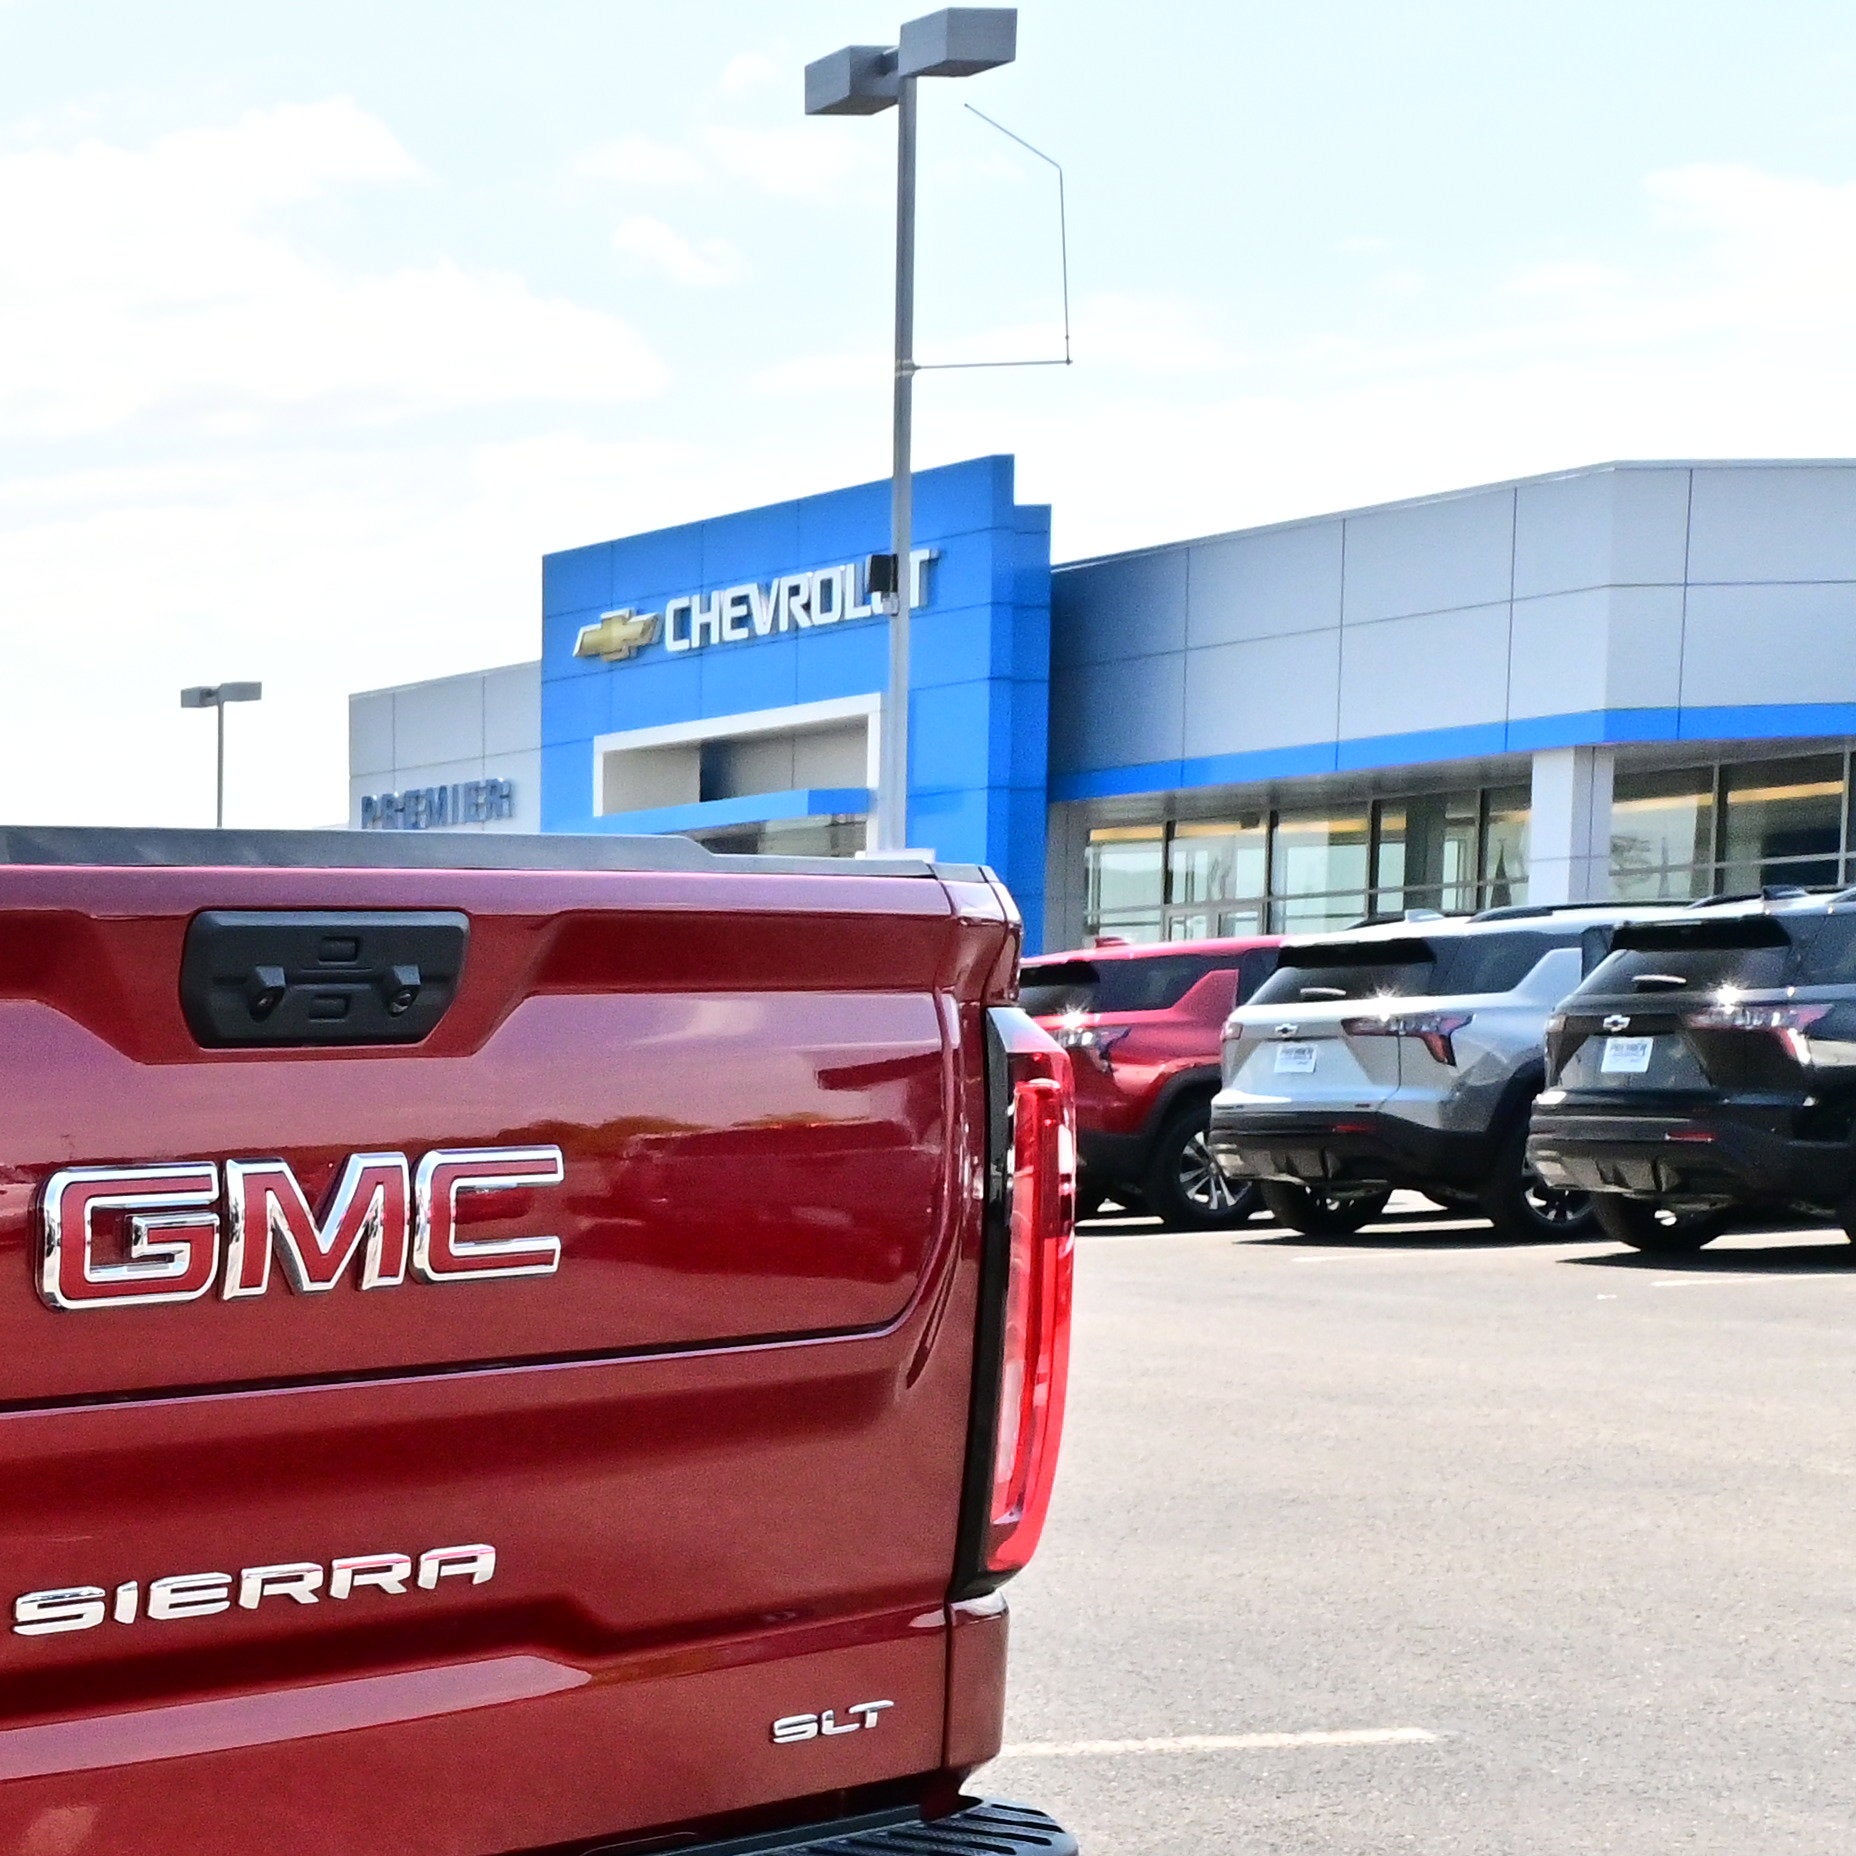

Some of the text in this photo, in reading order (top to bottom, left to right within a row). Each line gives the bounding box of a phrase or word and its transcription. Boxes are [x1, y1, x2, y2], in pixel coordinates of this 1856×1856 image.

[664, 549, 936, 652] CHEVROLT
[36, 1144, 565, 1310] GMC
[12, 1543, 497, 1637] SIERRA
[772, 1699, 895, 1744] SLT
